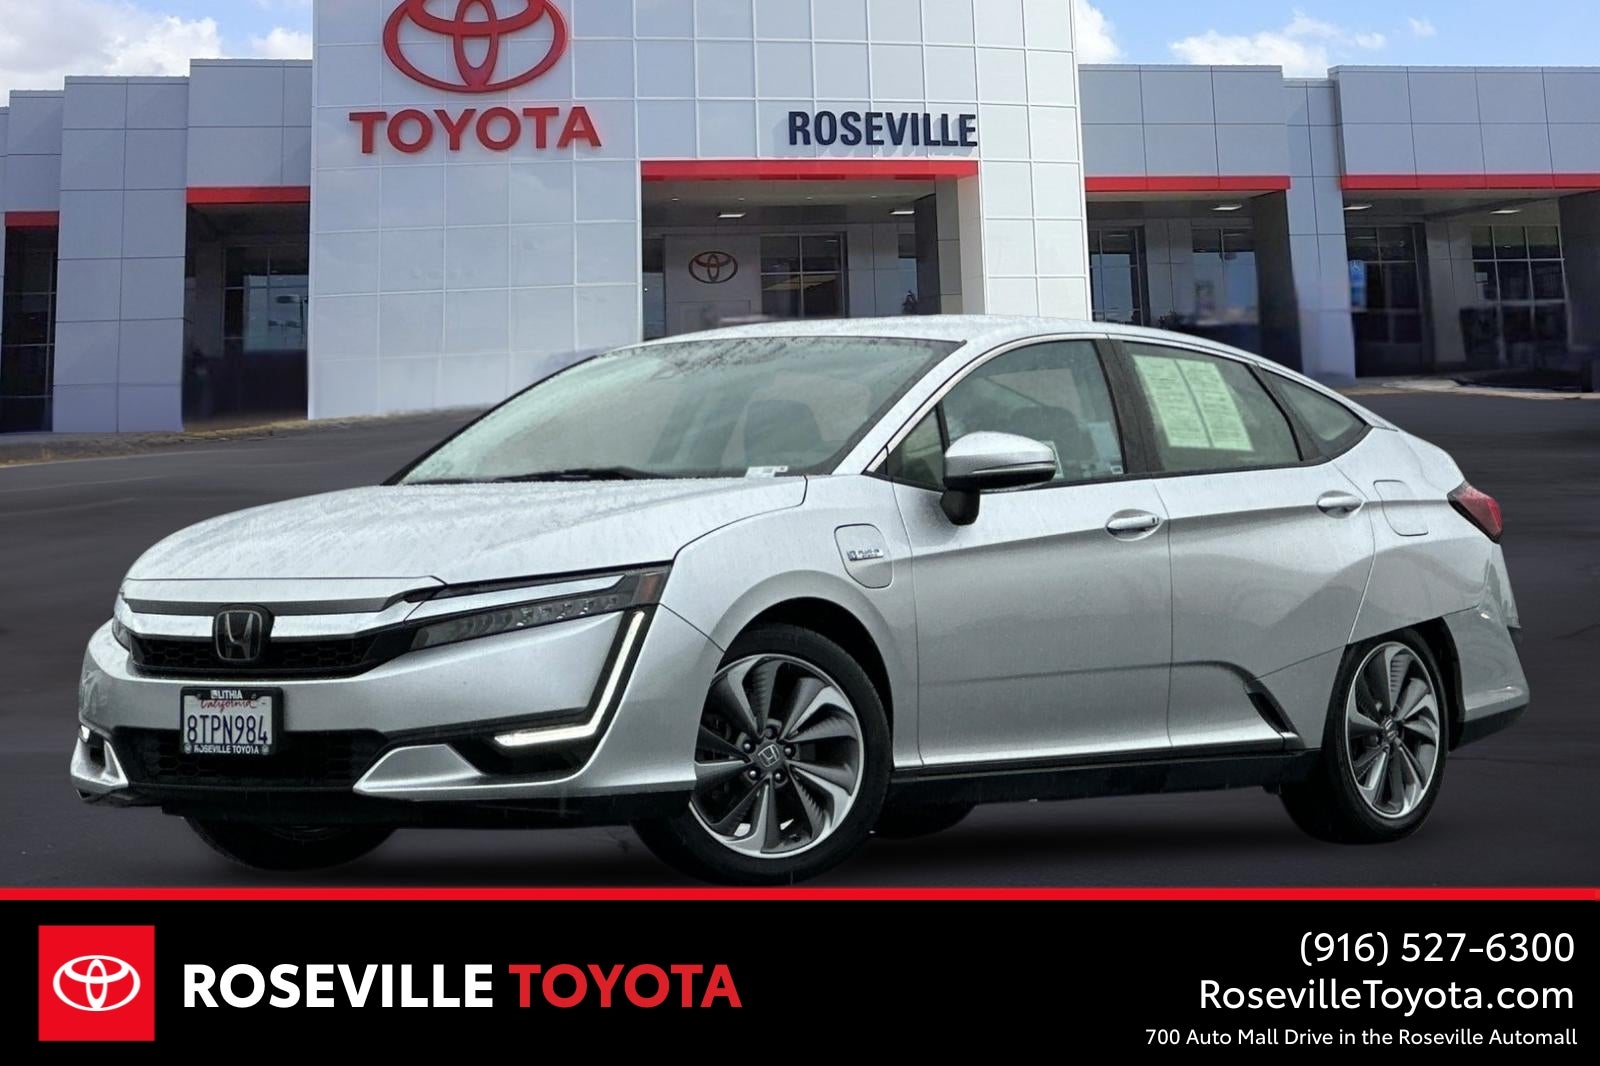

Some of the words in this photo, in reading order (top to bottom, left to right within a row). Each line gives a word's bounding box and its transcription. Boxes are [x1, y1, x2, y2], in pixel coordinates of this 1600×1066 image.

[349, 106, 601, 154] TOYOTA
[788, 111, 978, 147] ROSEVILLE
[218, 689, 243, 699] LITHIA
[200, 699, 257, 713] California
[187, 714, 268, 744] 8TPN984
[194, 744, 231, 754] ROSEVILLE
[232, 745, 259, 754] TOYOTA
